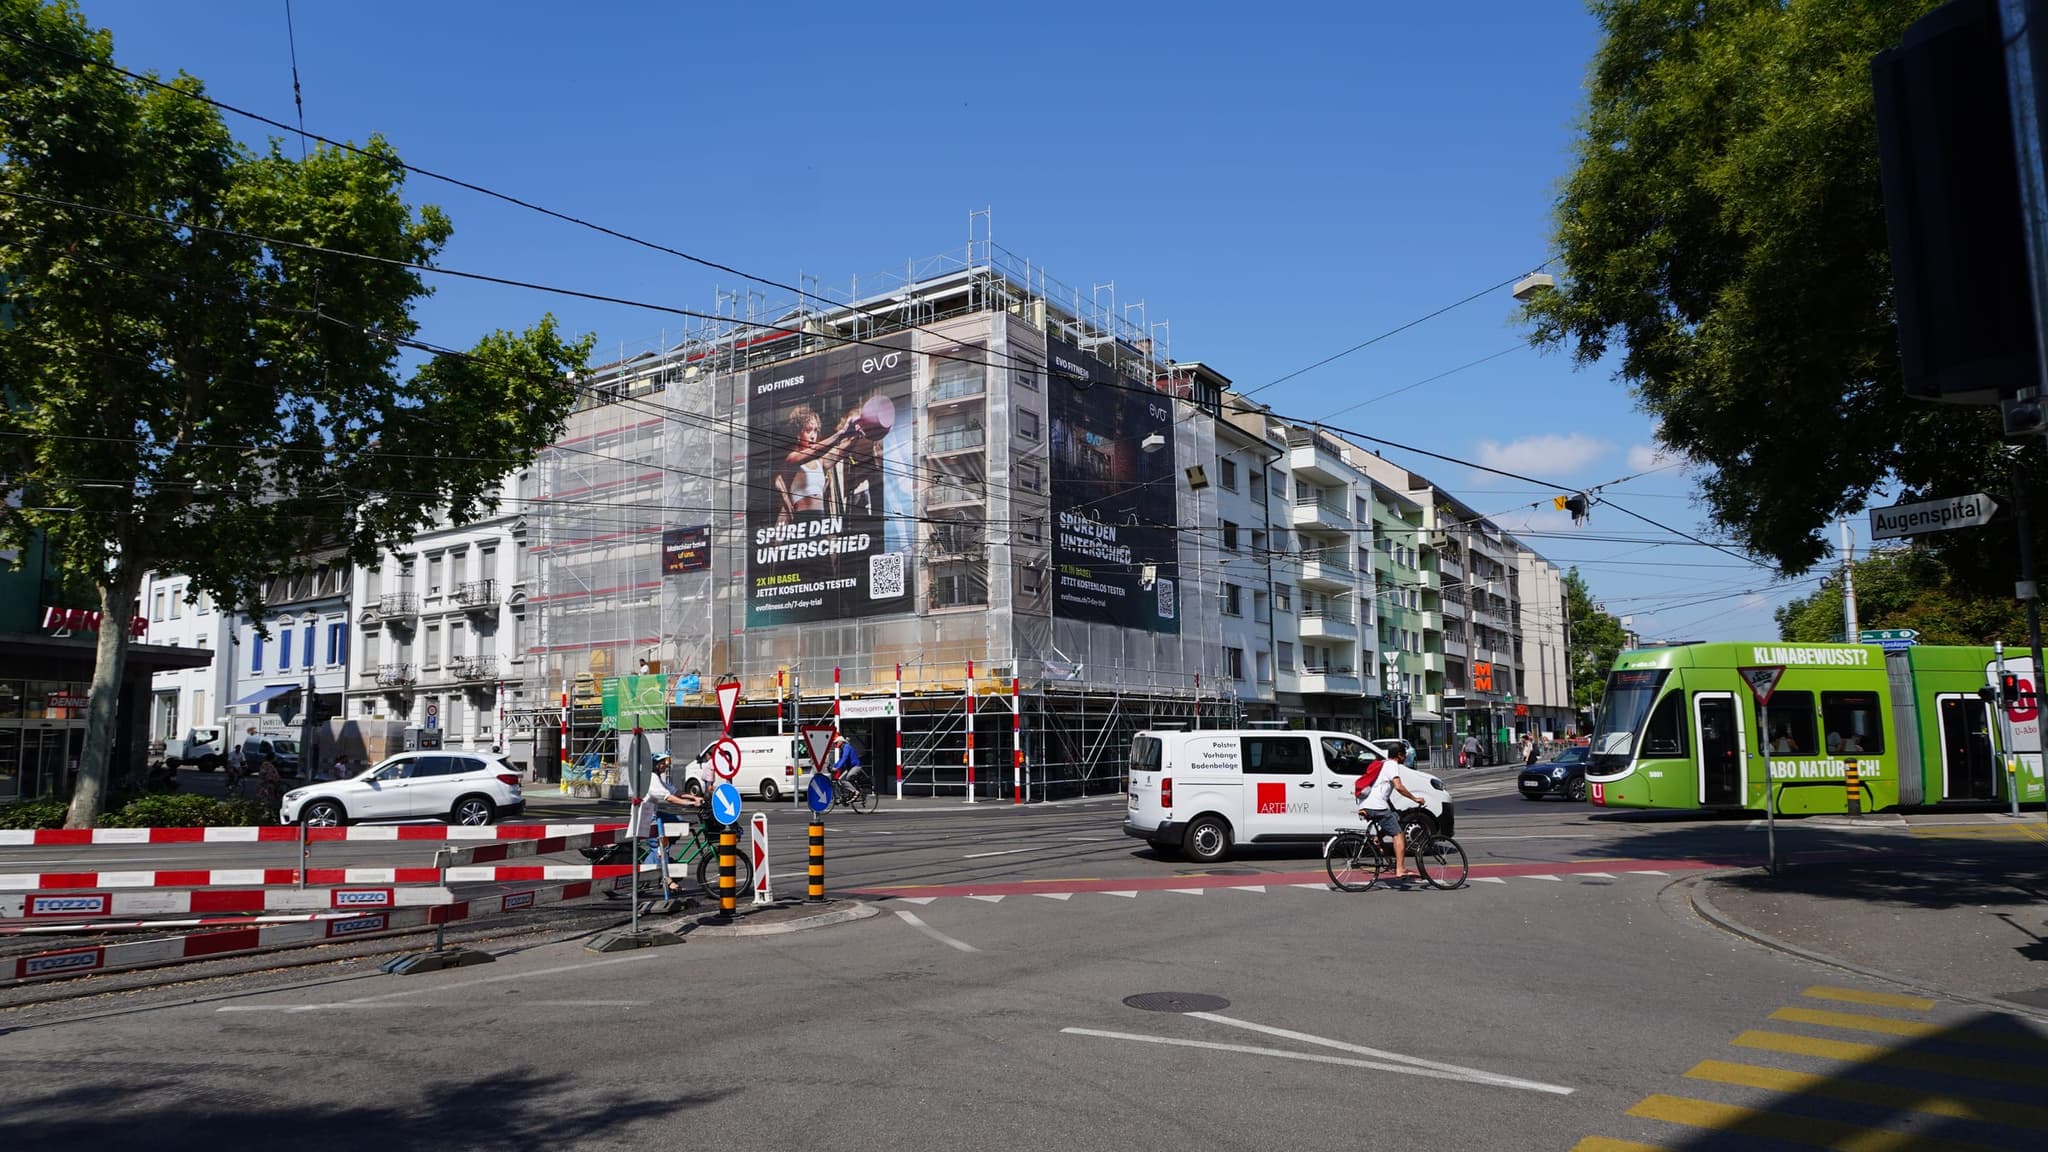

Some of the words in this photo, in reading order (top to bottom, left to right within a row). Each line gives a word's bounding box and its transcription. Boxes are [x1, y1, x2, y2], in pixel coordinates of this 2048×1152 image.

[862, 352, 902, 374] evo
[1055, 356, 1067, 369] EVO
[1068, 362, 1089, 379] FITNESS
[757, 384, 773, 395] EVO
[774, 375, 805, 391] FITNESS
[1149, 403, 1167, 421] evo
[1875, 498, 1981, 532] Augenspital
[755, 521, 807, 545] SPÜRE
[809, 515, 843, 537] DEN
[1060, 511, 1094, 535] SPÜRE
[1096, 525, 1116, 542] DEN
[756, 533, 870, 564] UNTERSCHIED
[1060, 532, 1131, 565] UNTERSCHIED
[756, 577, 767, 586] 2X
[767, 575, 776, 585] IN
[777, 573, 801, 584] BASEL
[1075, 567, 1092, 578] BASEL
[755, 586, 777, 598] JETZT
[778, 581, 824, 595] KOSTENLOS
[825, 578, 857, 590] TESTEN
[1060, 576, 1076, 588] JETZT
[1077, 579, 1107, 593] KOSTENLOS
[1107, 586, 1126, 597] TESTEN
[42, 606, 149, 637] DENR
[1753, 647, 1868, 665] KLIMABEWUSST?
[1475, 663, 1491, 676] M
[1476, 677, 1492, 690] M
[50, 698, 89, 706] DENNE
[2015, 725, 2038, 736] U-Abo
[1770, 761, 1796, 778] ABO
[1800, 756, 1881, 778] NATÜRCH!
[1261, 802, 1309, 813] ARTEMYR
[35, 899, 101, 911] TOZZO
[338, 892, 386, 903] TOZZO
[334, 918, 382, 932] TOZZO
[28, 954, 96, 971] TOZZO
